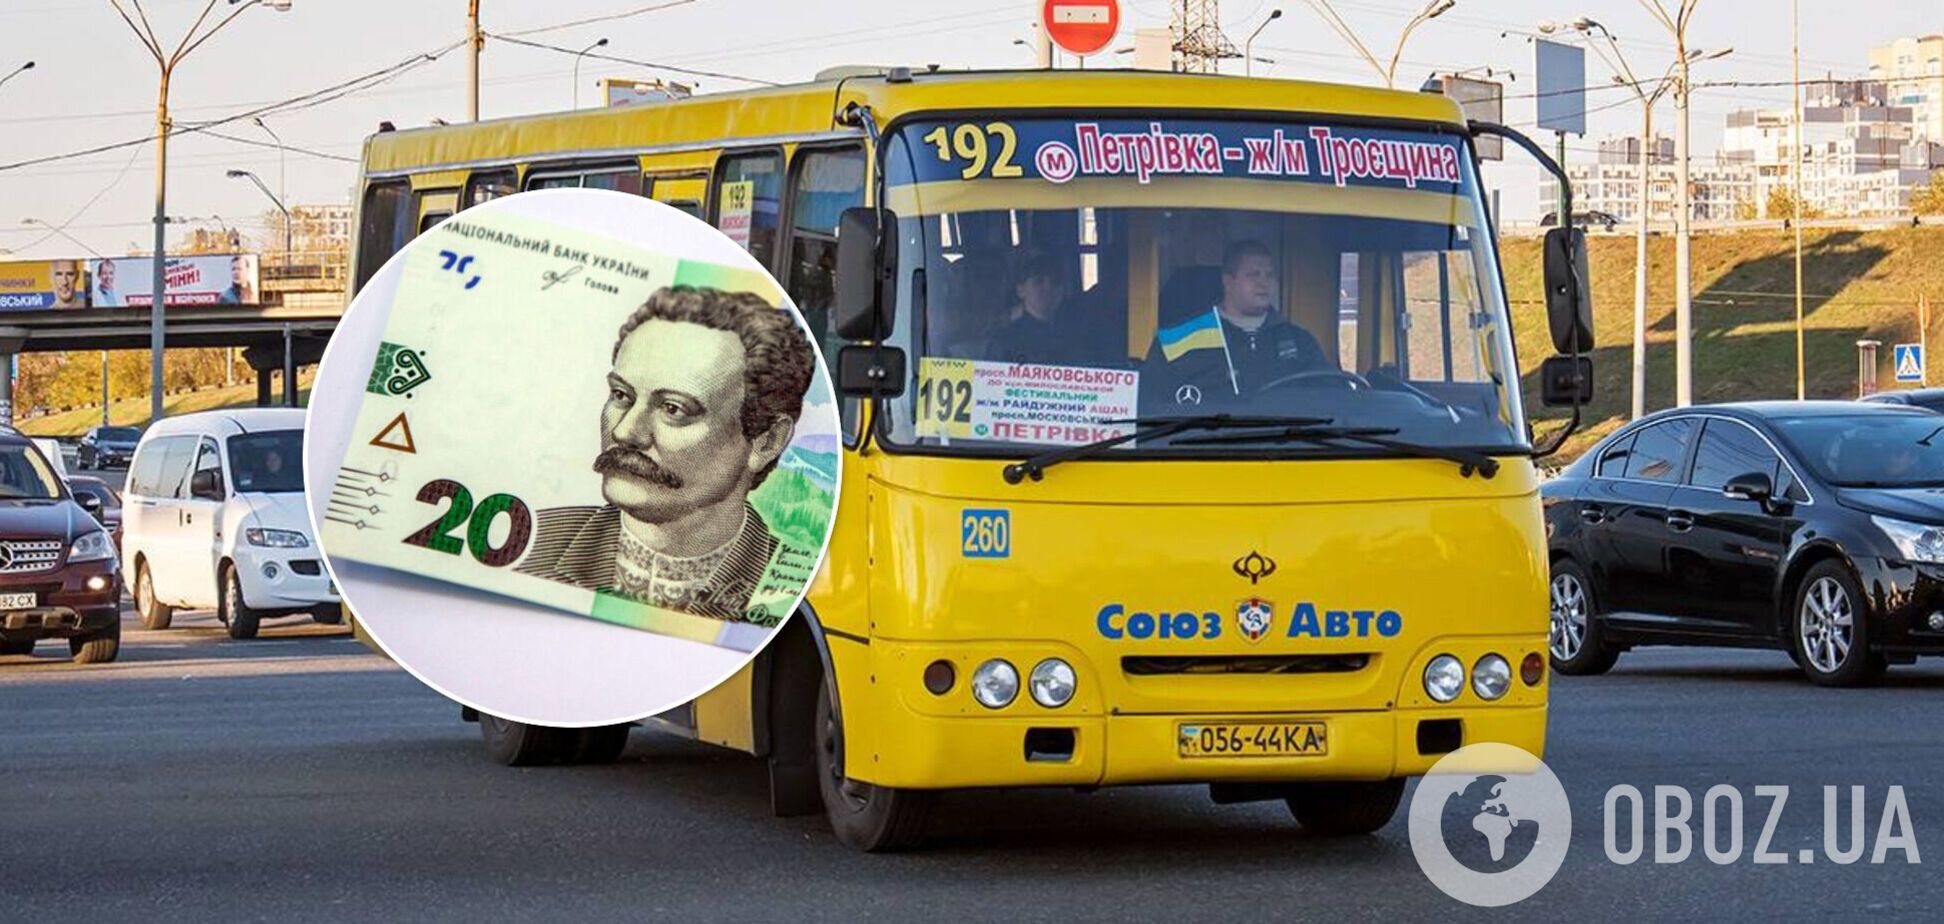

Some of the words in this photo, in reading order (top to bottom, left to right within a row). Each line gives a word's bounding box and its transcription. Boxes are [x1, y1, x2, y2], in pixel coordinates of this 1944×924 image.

[924, 122, 1023, 179] 192
[1076, 123, 1222, 183] Петрівка
[1244, 129, 1309, 175] ж/м
[1309, 127, 1461, 187] Троєщина
[729, 184, 746, 209] 192
[554, 245, 589, 263] БАНК
[593, 256, 650, 281] УКРАЇНИ
[919, 377, 972, 423] 192
[993, 422, 1122, 442] ПЕТРІВКА
[400, 478, 532, 568] 20
[964, 515, 1008, 553] 260
[1096, 603, 1222, 640] Союз
[1286, 602, 1402, 638] Авто
